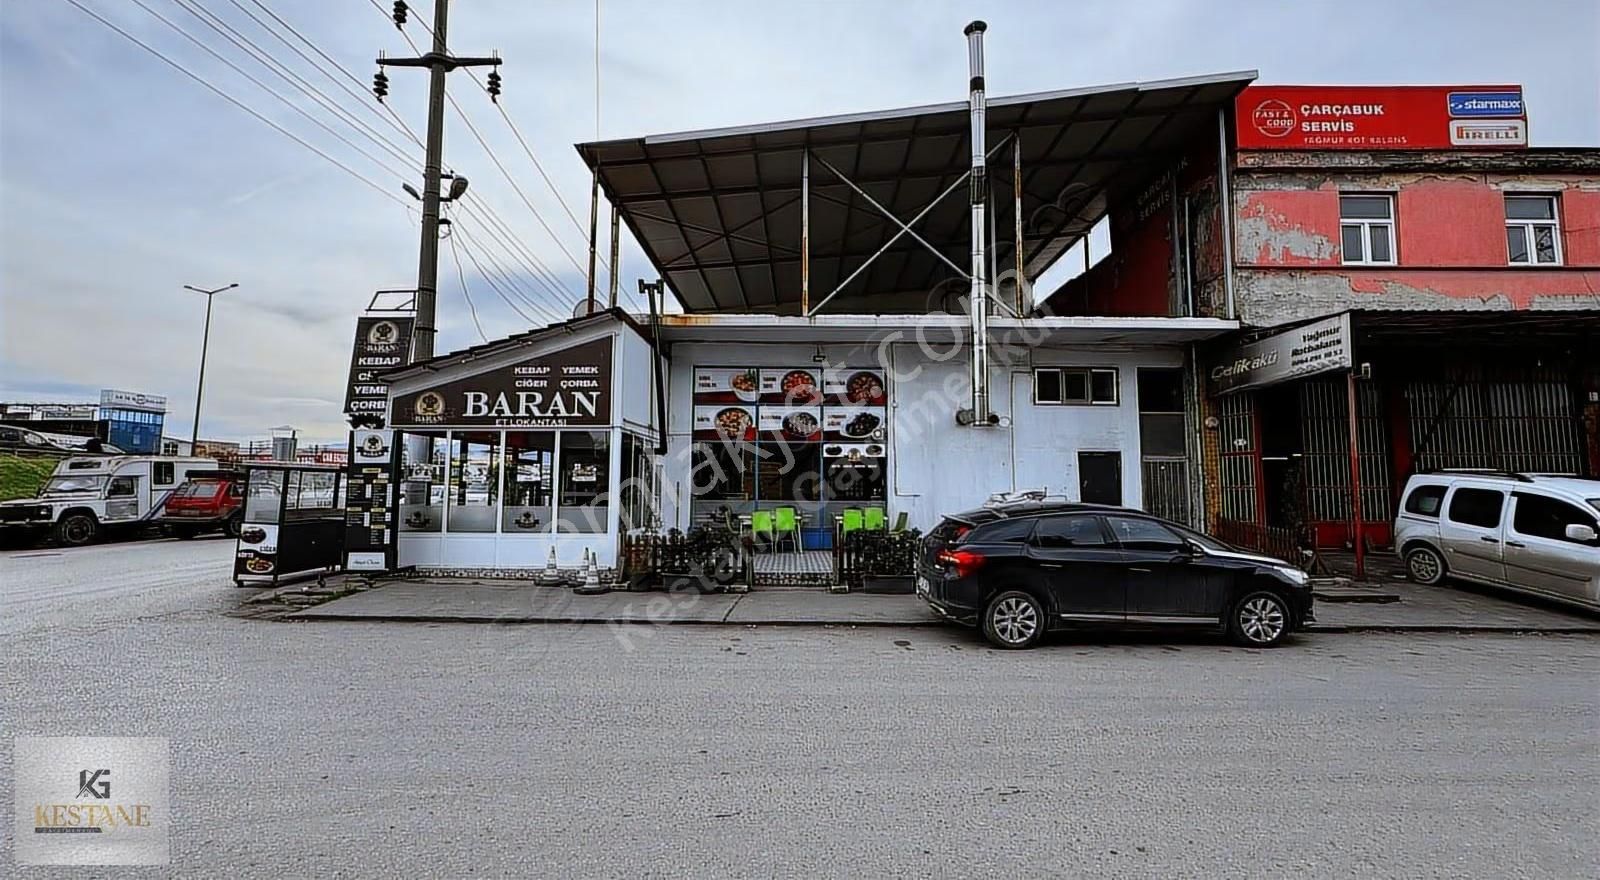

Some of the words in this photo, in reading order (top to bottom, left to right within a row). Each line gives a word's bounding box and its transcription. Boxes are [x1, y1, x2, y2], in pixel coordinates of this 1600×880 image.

[1464, 98, 1521, 110] starmaxx
[1255, 110, 1280, 118] FAST
[1301, 104, 1385, 117] ÇARÇABUK
[1301, 118, 1355, 132] SERVİS
[1456, 126, 1519, 140] PIRELLI
[1304, 136, 1344, 144] YAĞMUR
[358, 357, 401, 366] KEBAP
[514, 366, 551, 375] KEBAP
[561, 366, 599, 375] YEMEK
[353, 385, 388, 394] YEME
[515, 378, 548, 388] CİĞER
[560, 380, 599, 390] ÇORBA
[350, 400, 386, 411] ÇORB
[463, 391, 601, 417] BARAN
[509, 418, 567, 426] LOKANTASI
